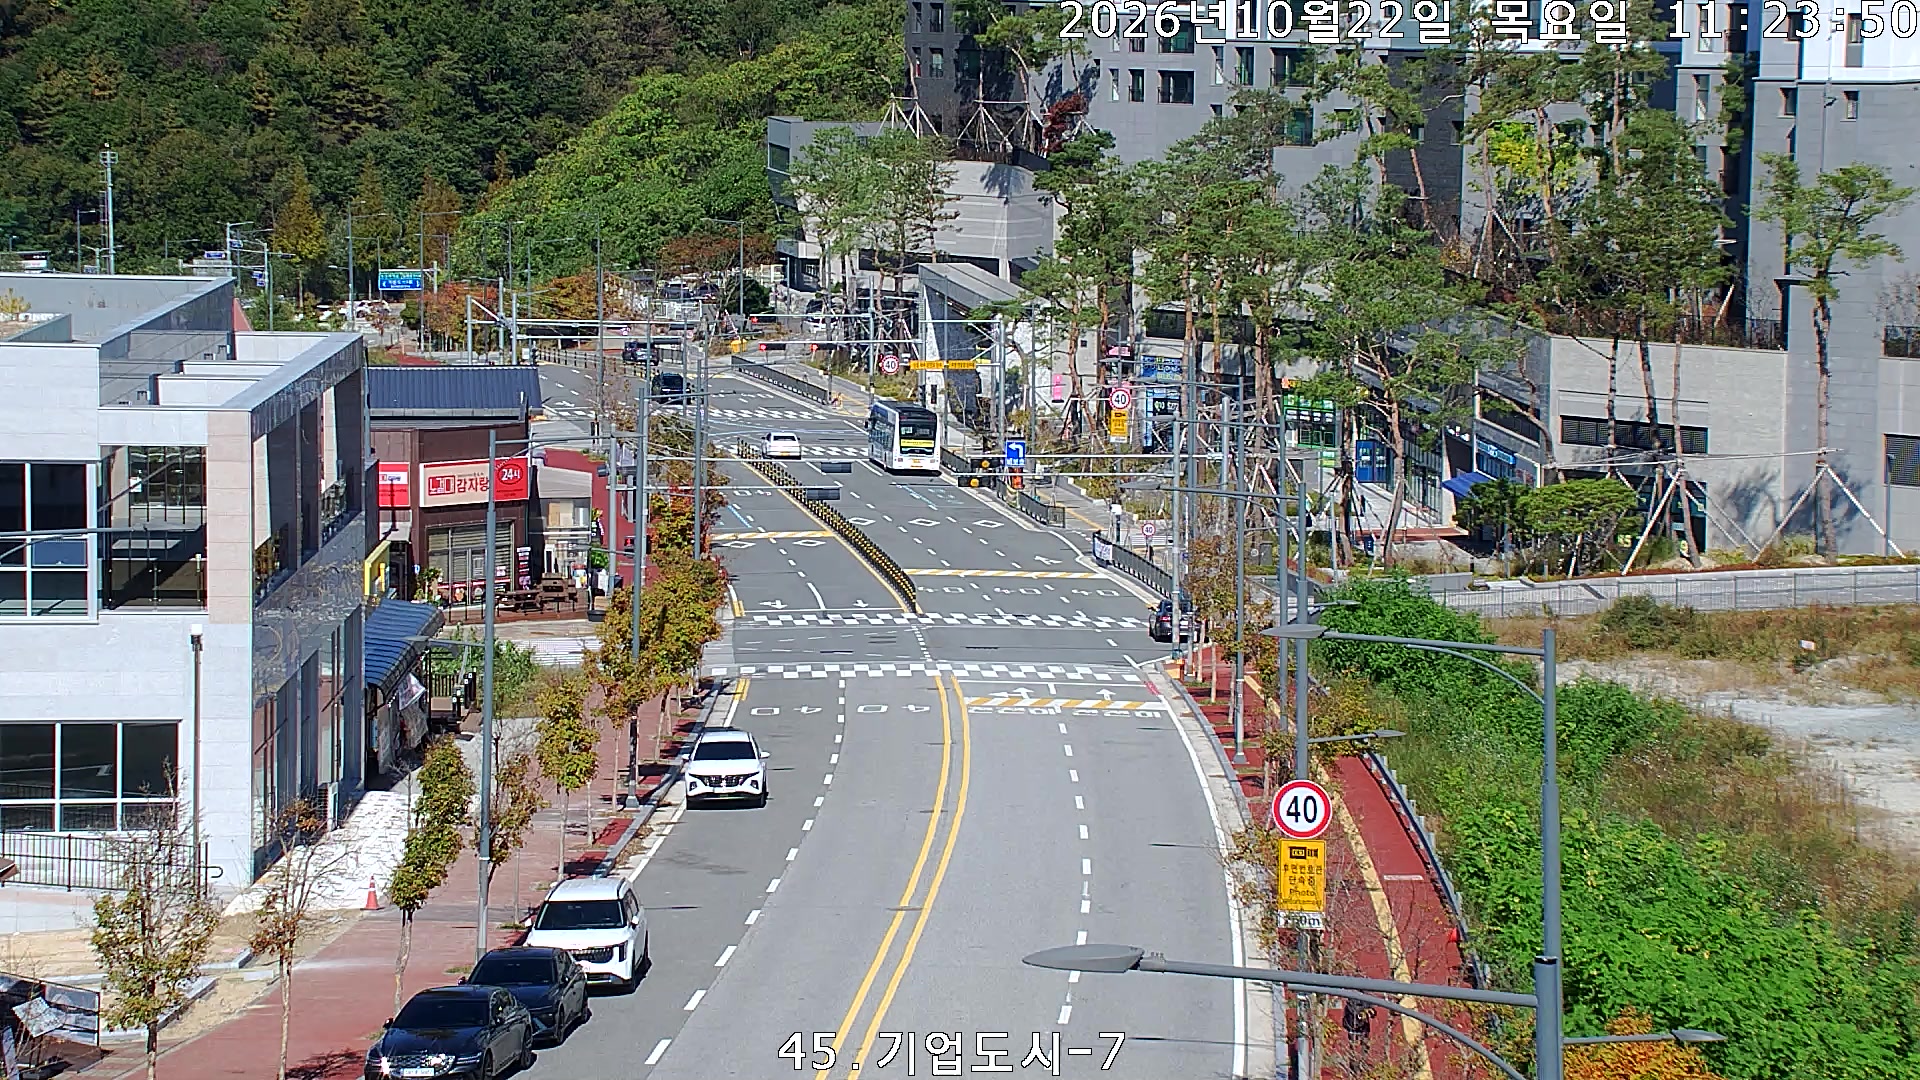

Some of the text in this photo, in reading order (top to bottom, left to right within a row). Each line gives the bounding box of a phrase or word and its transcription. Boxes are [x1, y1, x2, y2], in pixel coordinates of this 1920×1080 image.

[885, 361, 896, 370] 40
[1114, 394, 1126, 404] 40
[501, 468, 521, 481] 24시
[1286, 795, 1318, 824] 40
[1289, 887, 1316, 897] Photo
